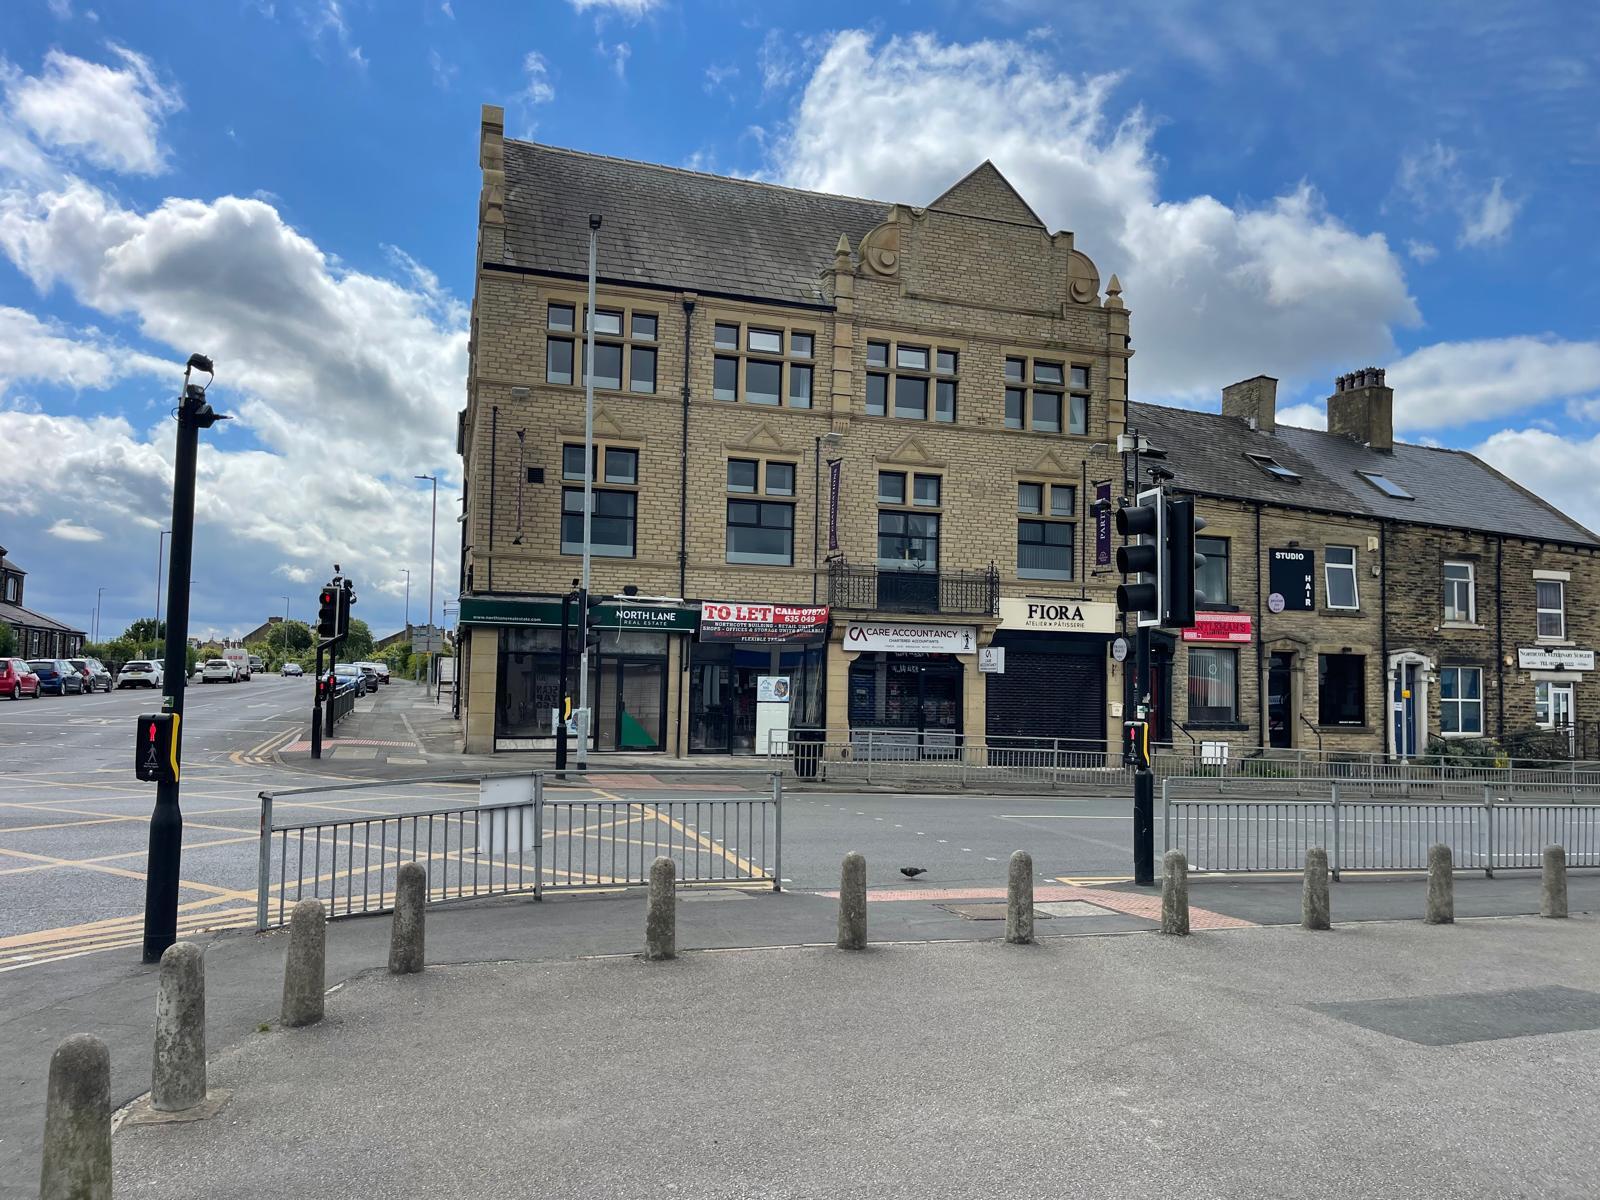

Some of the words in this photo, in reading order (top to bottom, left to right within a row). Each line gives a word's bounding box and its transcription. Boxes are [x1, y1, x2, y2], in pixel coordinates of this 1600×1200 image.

[1275, 552, 1304, 561] STUDIO
[1304, 575, 1312, 607] HAIR
[616, 610, 650, 620] NORTH
[651, 611, 676, 621] LANE
[705, 605, 731, 620] TO
[736, 606, 772, 621] LET
[775, 607, 801, 615] CALL:
[802, 608, 826, 616] 07870
[1027, 604, 1084, 621] FIORA
[784, 615, 799, 623] 635
[866, 627, 890, 636] CARE
[892, 629, 959, 639] ACCOUNTANCY
